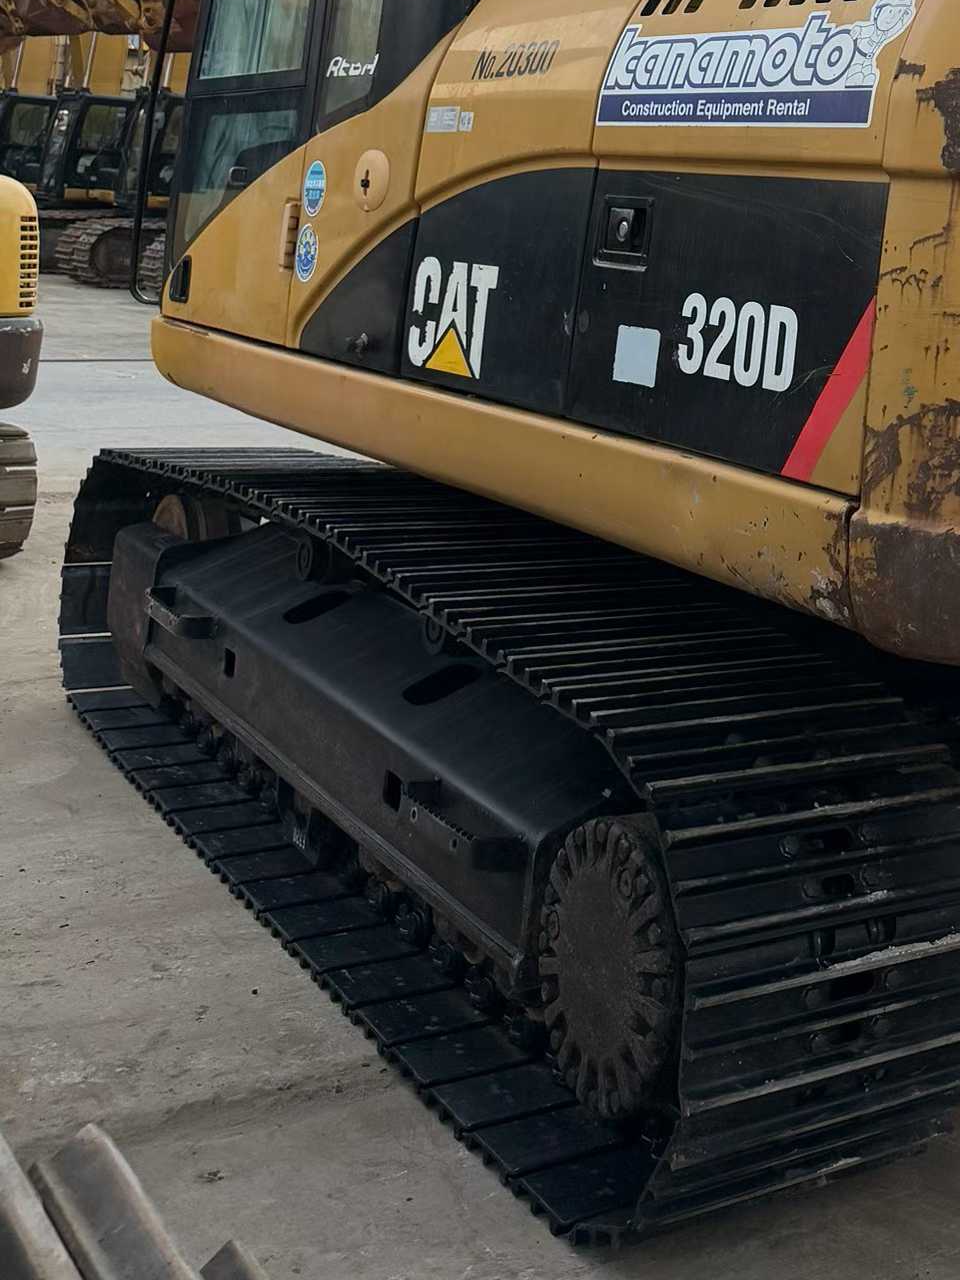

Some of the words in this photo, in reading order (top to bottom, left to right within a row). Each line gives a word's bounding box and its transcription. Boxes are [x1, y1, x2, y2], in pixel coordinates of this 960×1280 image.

[603, 14, 856, 89] kanamoto
[621, 99, 693, 117] Construction
[696, 99, 763, 120] Equipment
[766, 98, 811, 117] Rental
[407, 255, 500, 379] CAT
[677, 292, 799, 392] 320D
